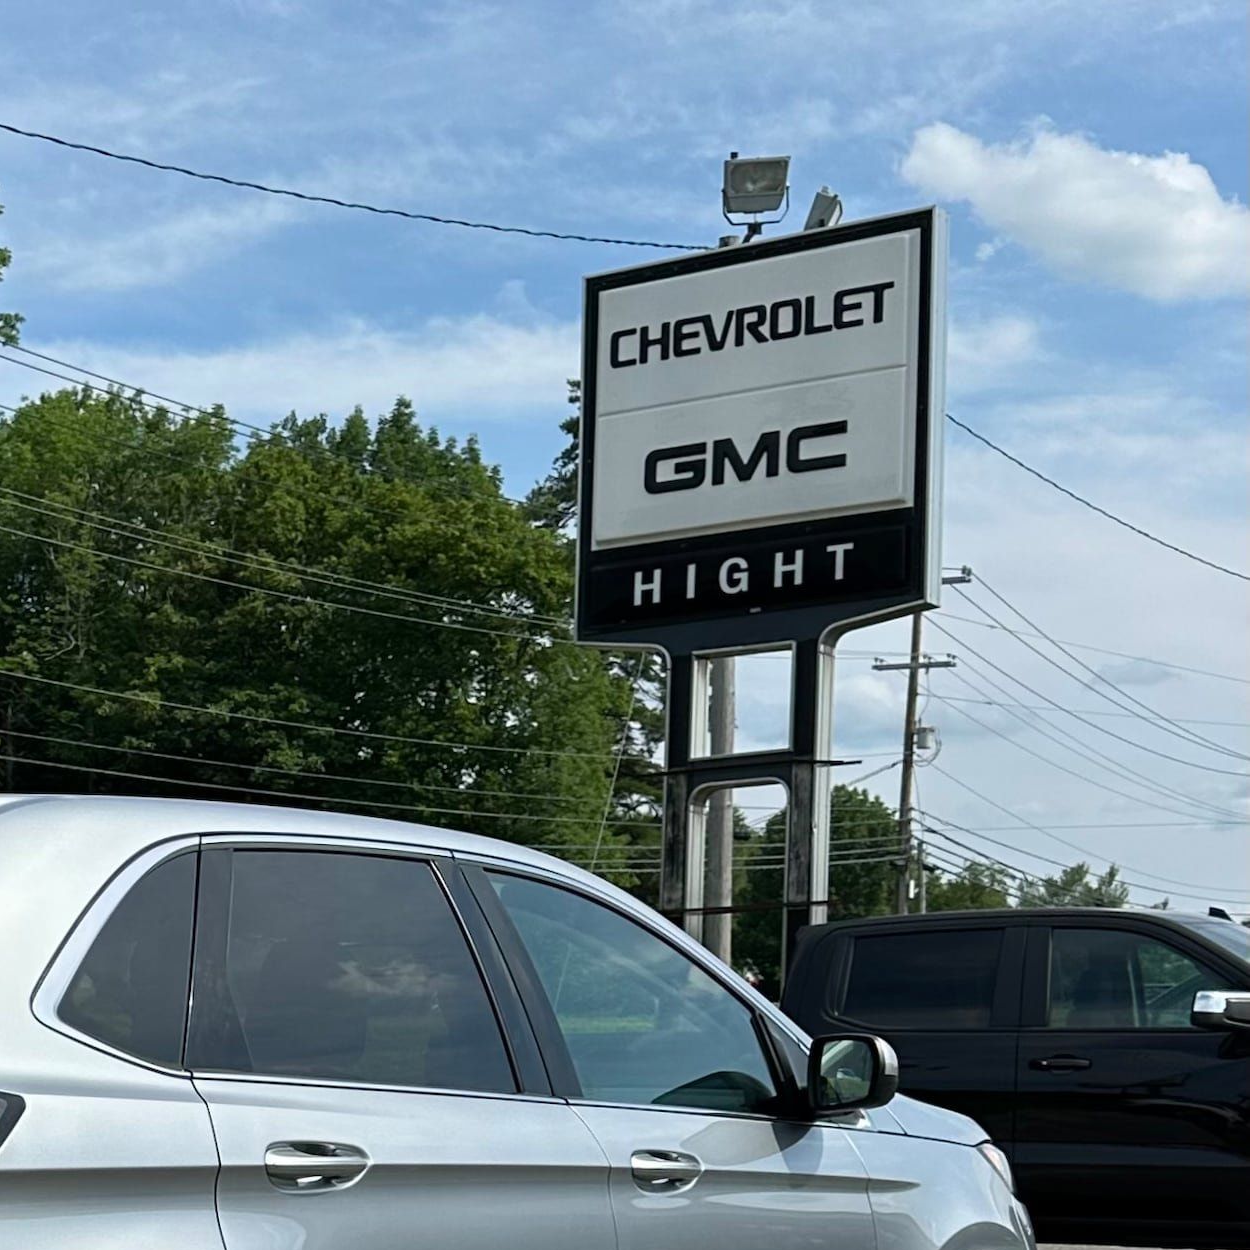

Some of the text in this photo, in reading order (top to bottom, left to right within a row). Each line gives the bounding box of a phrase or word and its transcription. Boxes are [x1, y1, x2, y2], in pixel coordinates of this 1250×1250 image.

[609, 280, 895, 369] CHEVROLET
[643, 419, 848, 495] GMC
[632, 541, 855, 607] HIGHT
